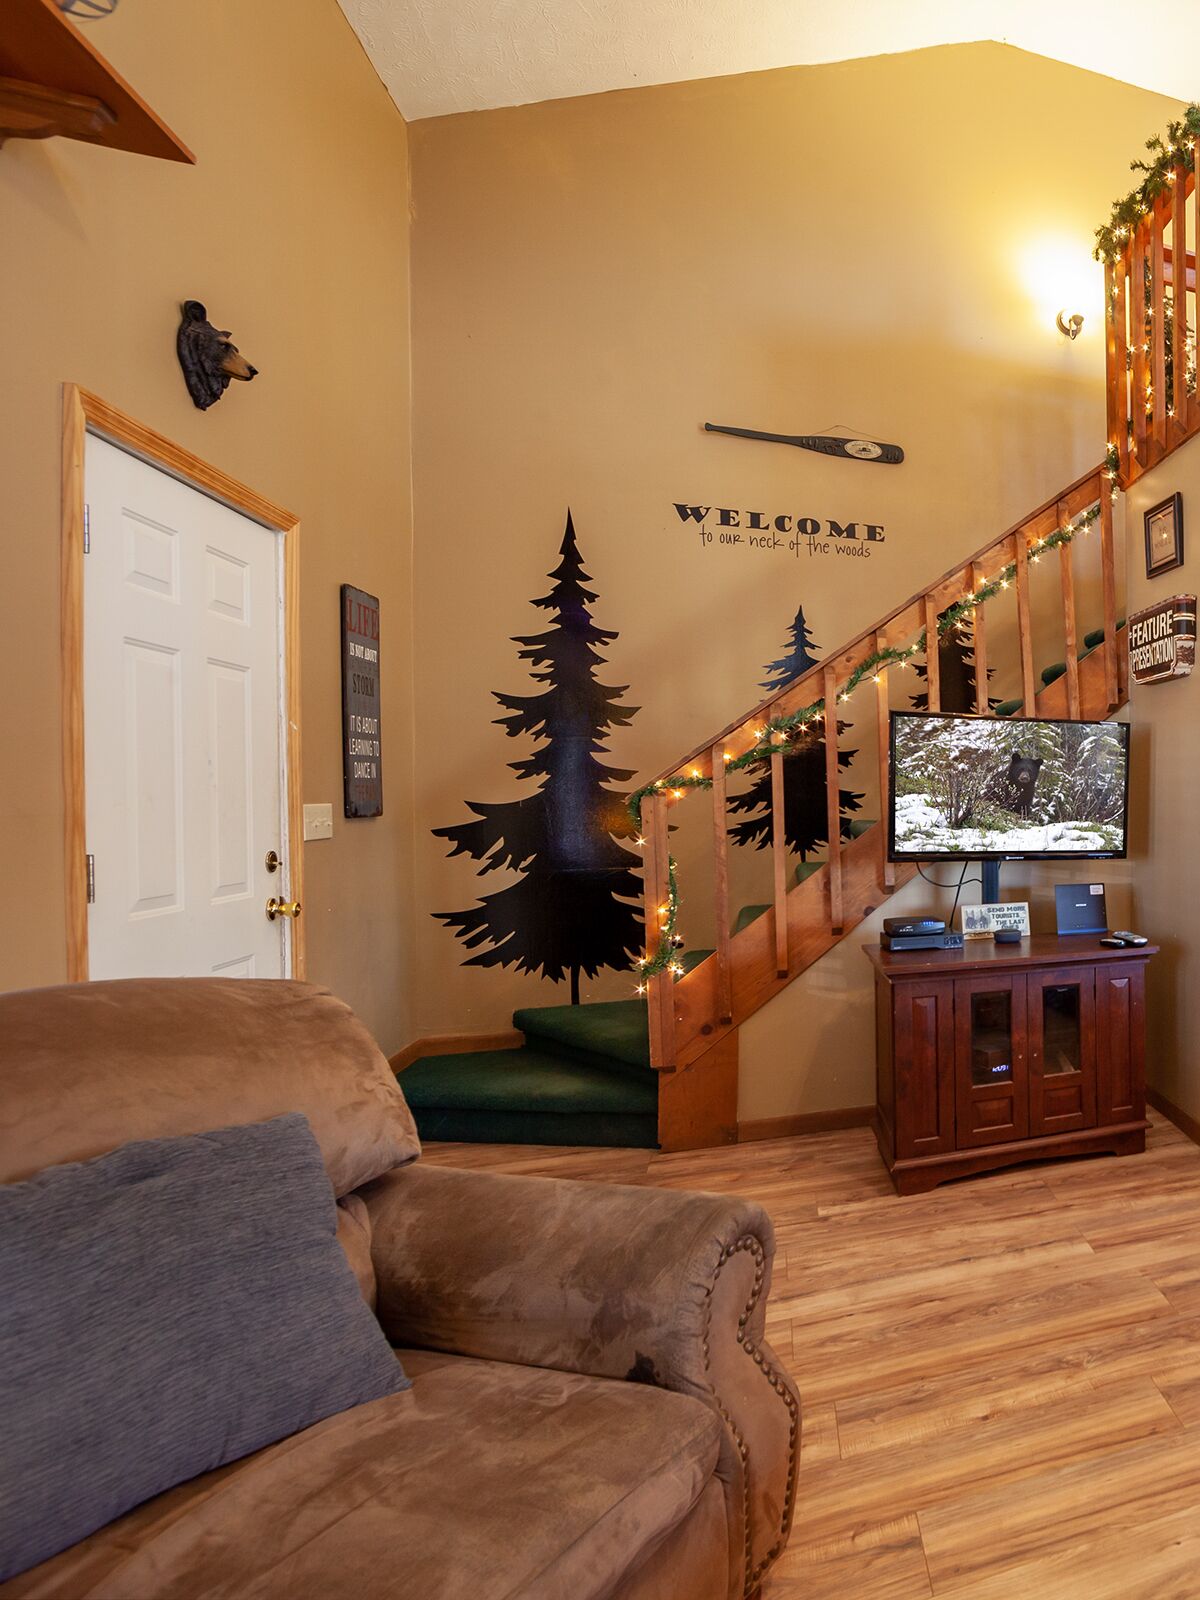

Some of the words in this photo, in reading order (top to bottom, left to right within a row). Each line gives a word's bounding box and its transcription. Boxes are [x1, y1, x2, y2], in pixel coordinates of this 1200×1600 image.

[672, 503, 885, 543] WELCOME
[699, 524, 713, 547] to
[750, 531, 785, 550] neck
[789, 530, 801, 558] of
[806, 535, 830, 557] the
[835, 541, 871, 558] woods
[346, 597, 379, 641] LIFE
[1132, 609, 1173, 648] FEATURE
[1132, 636, 1174, 672] PRESENTATION
[352, 673, 375, 698] STORM
[362, 717, 377, 735] ABOUT
